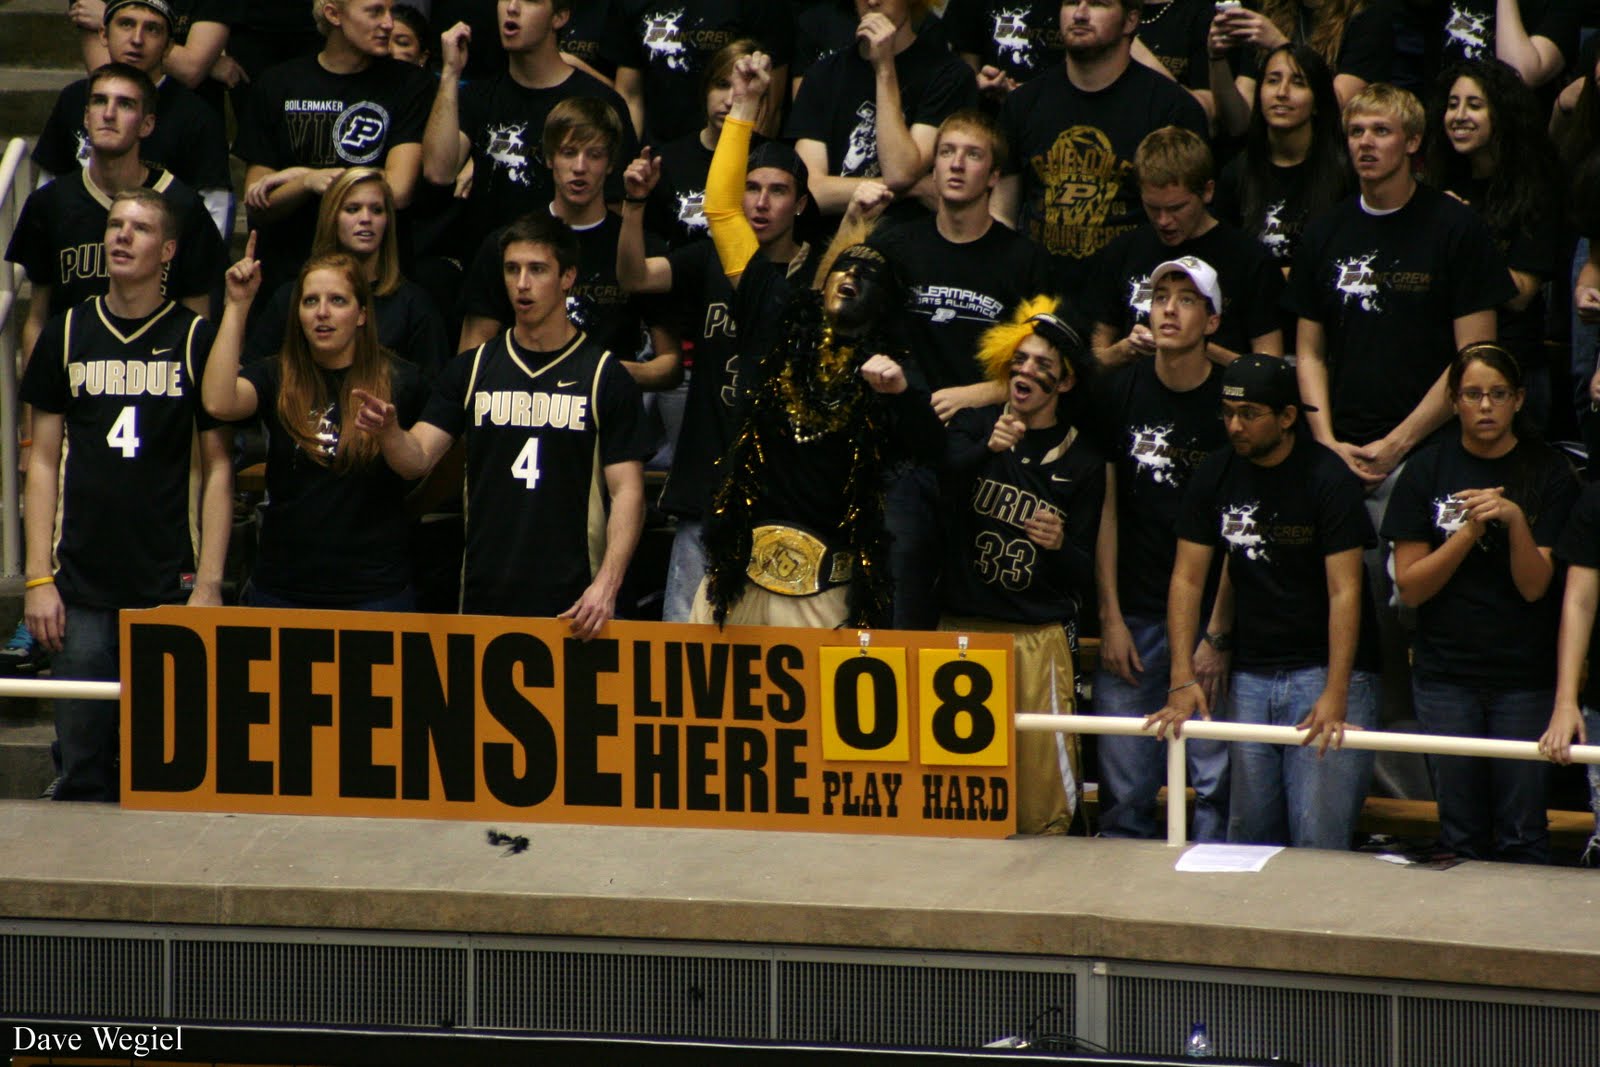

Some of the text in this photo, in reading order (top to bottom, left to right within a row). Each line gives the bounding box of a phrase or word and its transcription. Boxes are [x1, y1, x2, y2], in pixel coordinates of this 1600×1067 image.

[285, 100, 343, 112] BOILERMAKER
[945, 299, 997, 319] ALLIANCE
[68, 359, 184, 398] PURDUE
[105, 405, 140, 458] 4
[474, 390, 588, 431] PURDUE
[510, 436, 541, 489] 4
[976, 531, 1036, 591] 33
[633, 640, 806, 723] LIVES
[834, 656, 995, 754] 0 8
[130, 623, 622, 807] DEFENSE
[635, 724, 809, 814] HERE
[822, 771, 1008, 821] PLAY HARD
